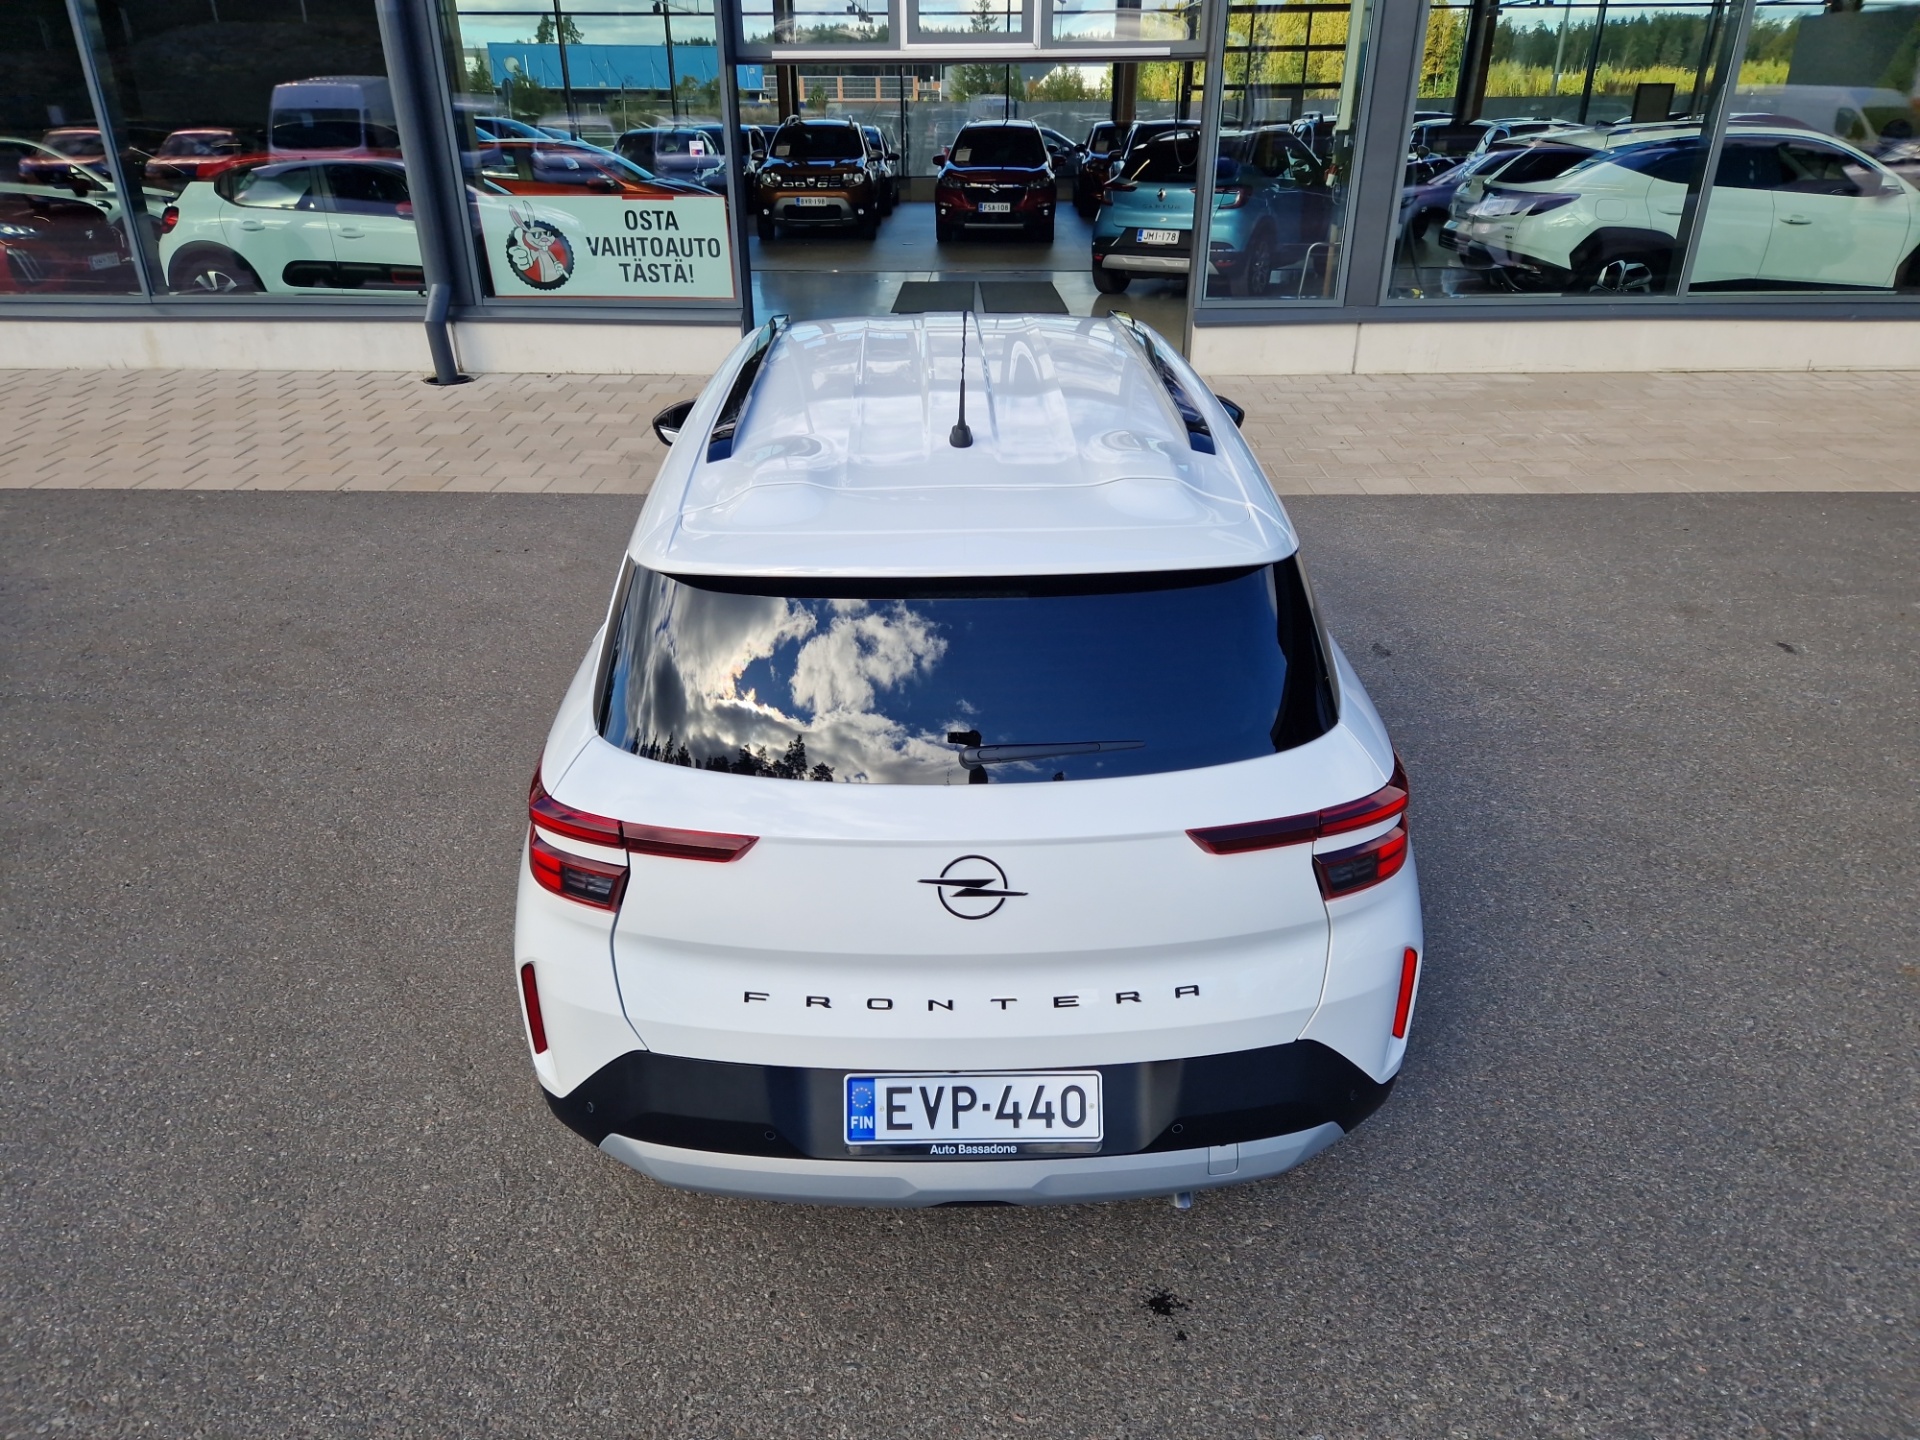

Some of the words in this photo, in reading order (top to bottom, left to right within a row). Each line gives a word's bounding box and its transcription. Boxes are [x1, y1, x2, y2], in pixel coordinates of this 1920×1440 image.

[624, 209, 680, 231] OSTA
[586, 236, 721, 258] VAIHTOAUTO
[1143, 231, 1177, 242] JMI-178
[619, 258, 695, 284] TÄSTÄ!
[743, 984, 1201, 1012] FRONTERA
[850, 1116, 874, 1130] FIN
[885, 1084, 1087, 1131] EVP-440
[930, 1144, 956, 1155] Auto
[958, 1144, 1017, 1155] Bassadone
